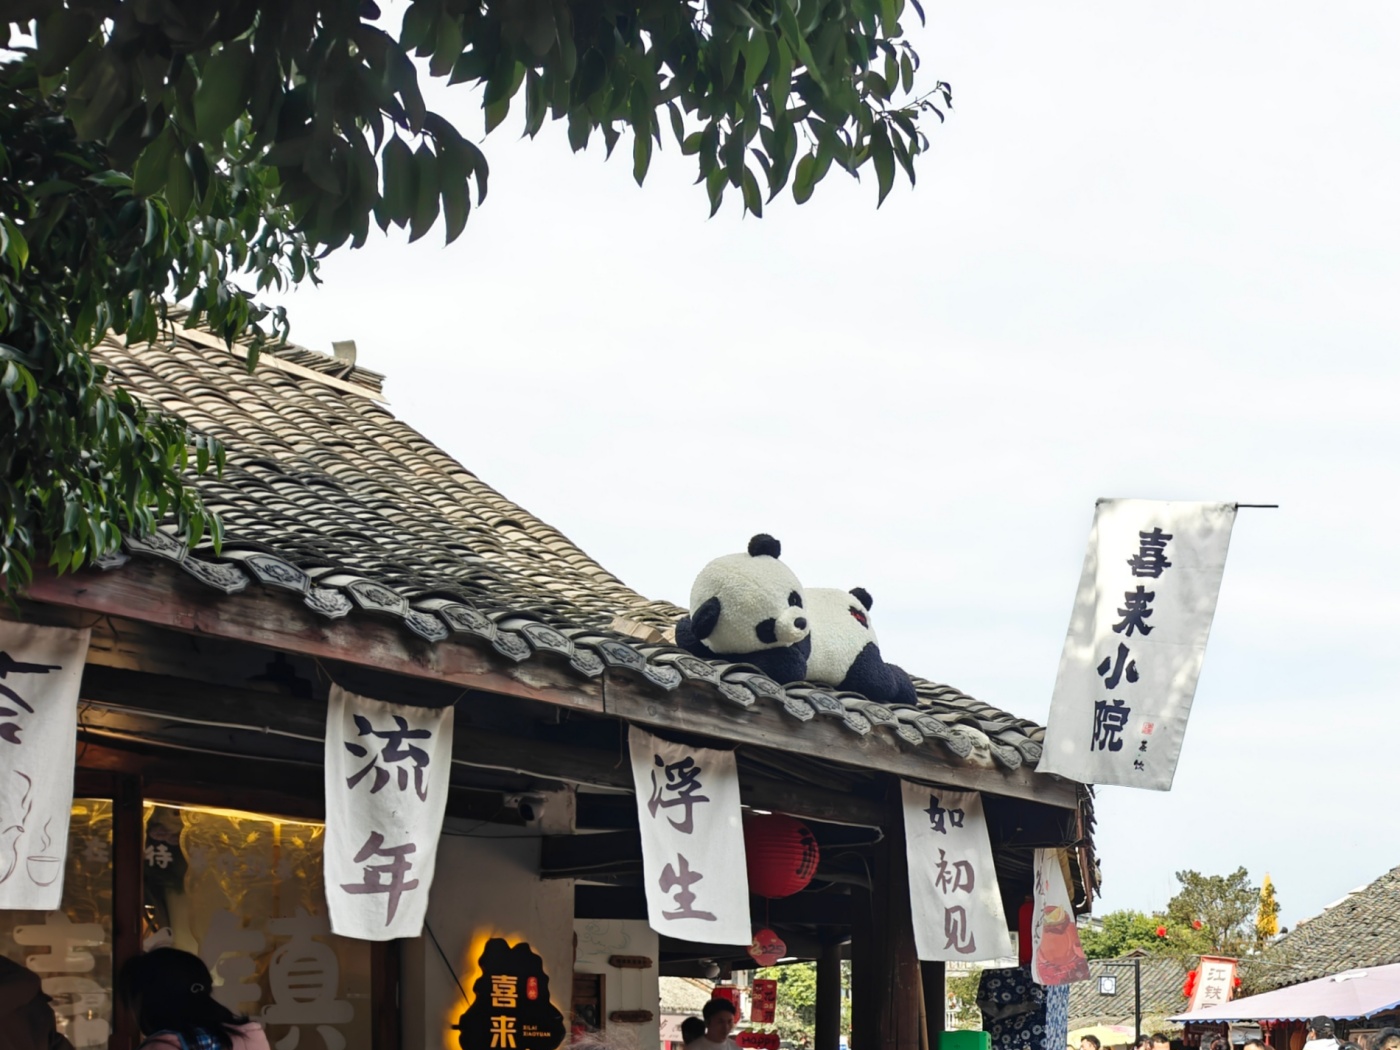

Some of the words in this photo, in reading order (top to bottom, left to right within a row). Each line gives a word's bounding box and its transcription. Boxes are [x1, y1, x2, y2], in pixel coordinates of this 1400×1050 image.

[1090, 527, 1173, 751] 喜来小院
[341, 714, 431, 927] 流年
[648, 754, 717, 921] 浮生
[923, 794, 976, 955] 如初见
[490, 975, 518, 1048] 喜来
[1201, 967, 1227, 1009] 江铁
